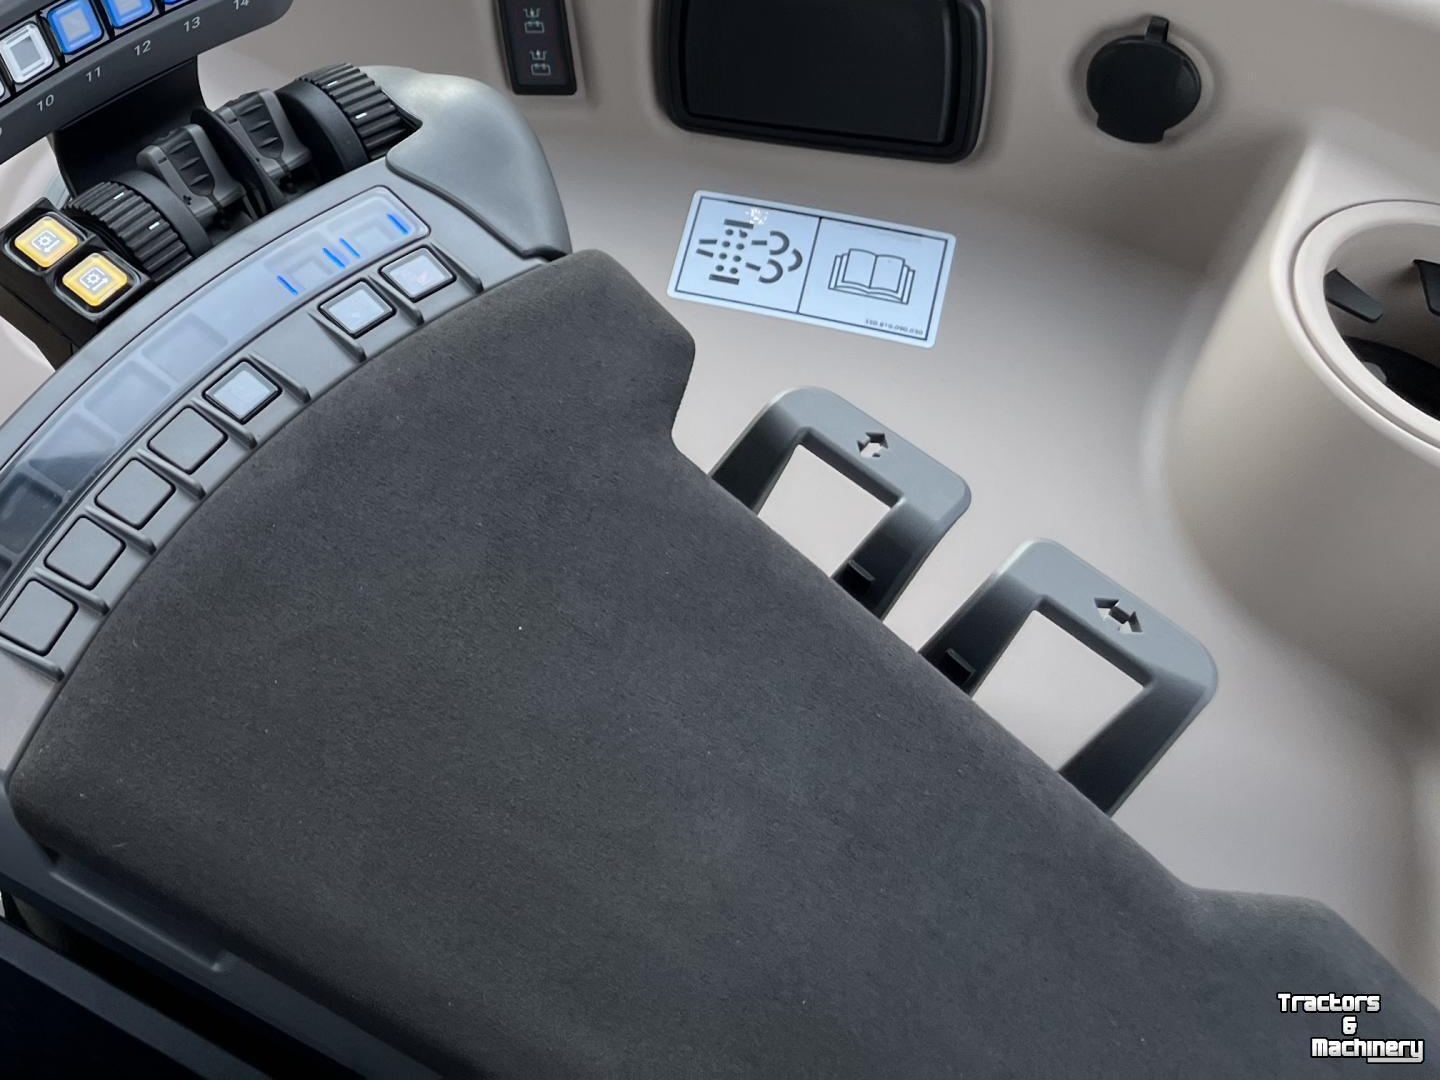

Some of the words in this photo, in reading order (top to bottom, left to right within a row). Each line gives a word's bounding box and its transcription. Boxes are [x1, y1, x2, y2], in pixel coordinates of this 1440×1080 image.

[183, 16, 201, 32] 13
[134, 40, 151, 57] 12
[85, 66, 101, 83] 11
[36, 94, 55, 112] 10
